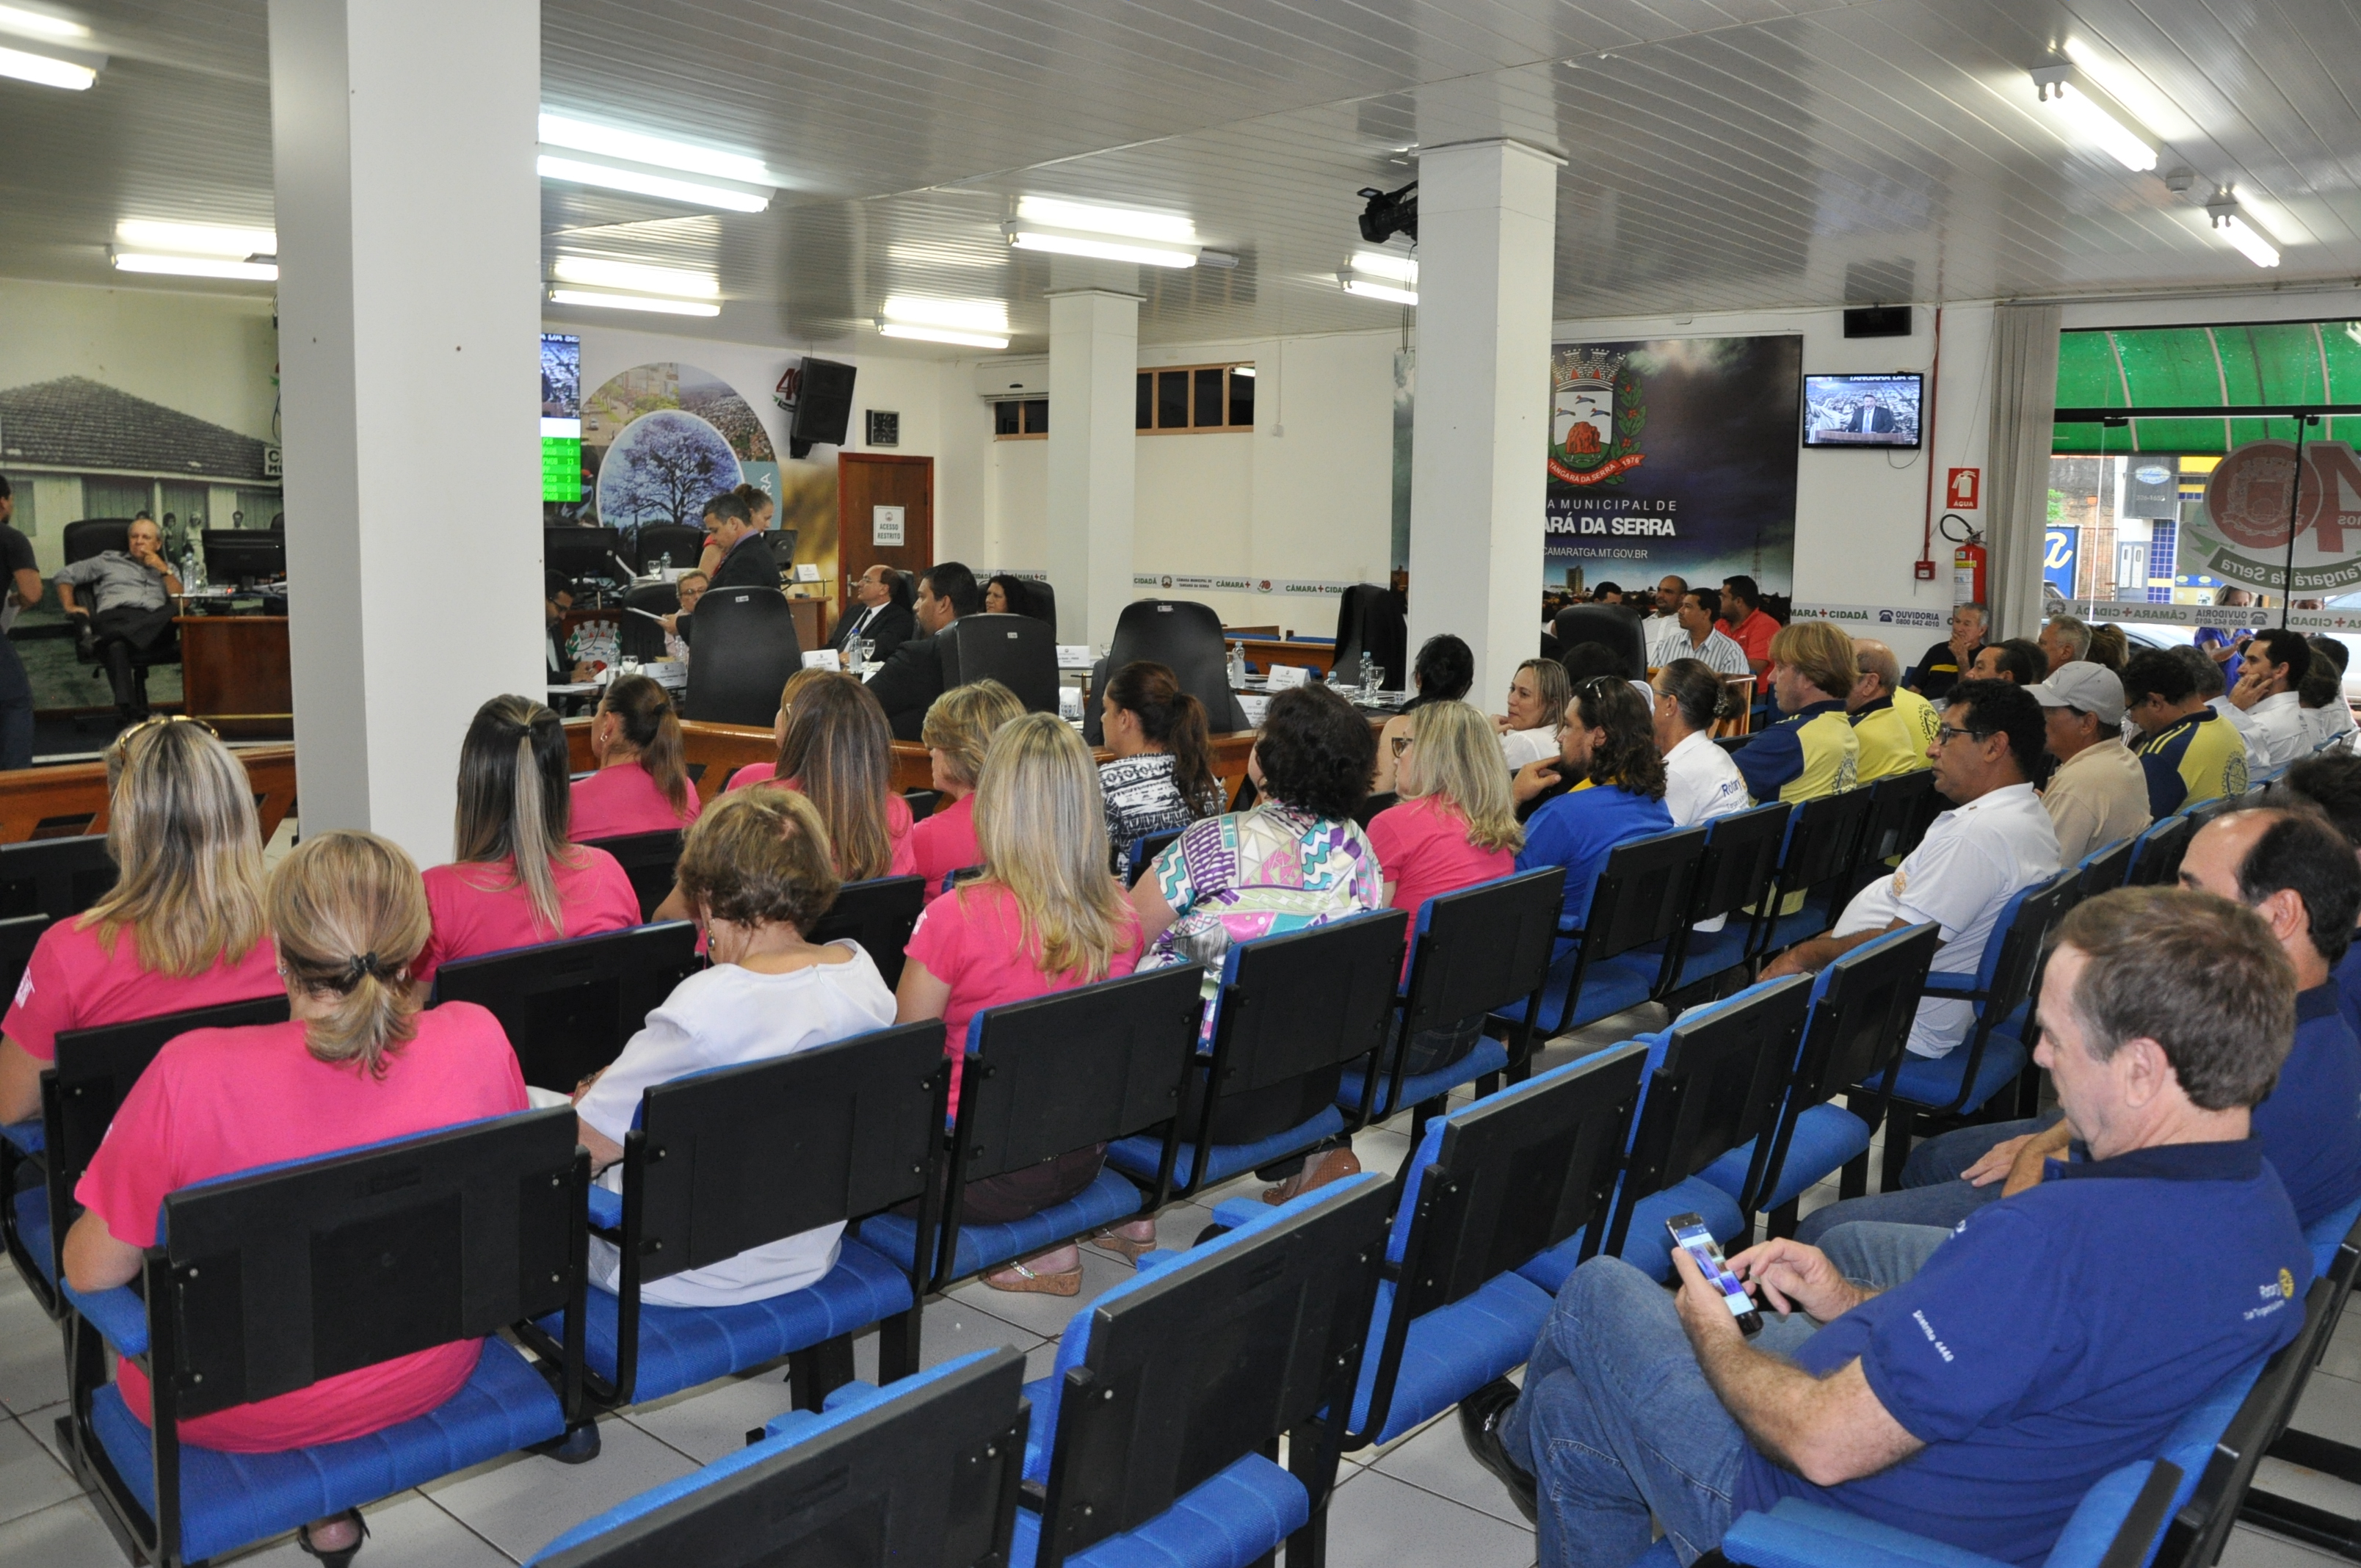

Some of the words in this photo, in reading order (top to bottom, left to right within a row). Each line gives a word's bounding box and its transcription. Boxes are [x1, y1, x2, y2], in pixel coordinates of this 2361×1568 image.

[1549, 462, 1579, 482] TANGARÁ
[1592, 464, 1615, 480] SERRA
[1622, 457, 1639, 466] 1976
[1561, 499, 1650, 511] MUNICIPAL
[1657, 501, 1677, 511] DE
[1581, 517, 1607, 534] DA
[1611, 518, 1676, 536] SERRA
[1216, 580, 1244, 588] CÂMARA
[1285, 584, 1317, 593] CÂMARA
[1829, 610, 1868, 620] CIDADÃ
[1896, 611, 1940, 621] OUVIDORIA
[1924, 620, 1940, 628] 4010
